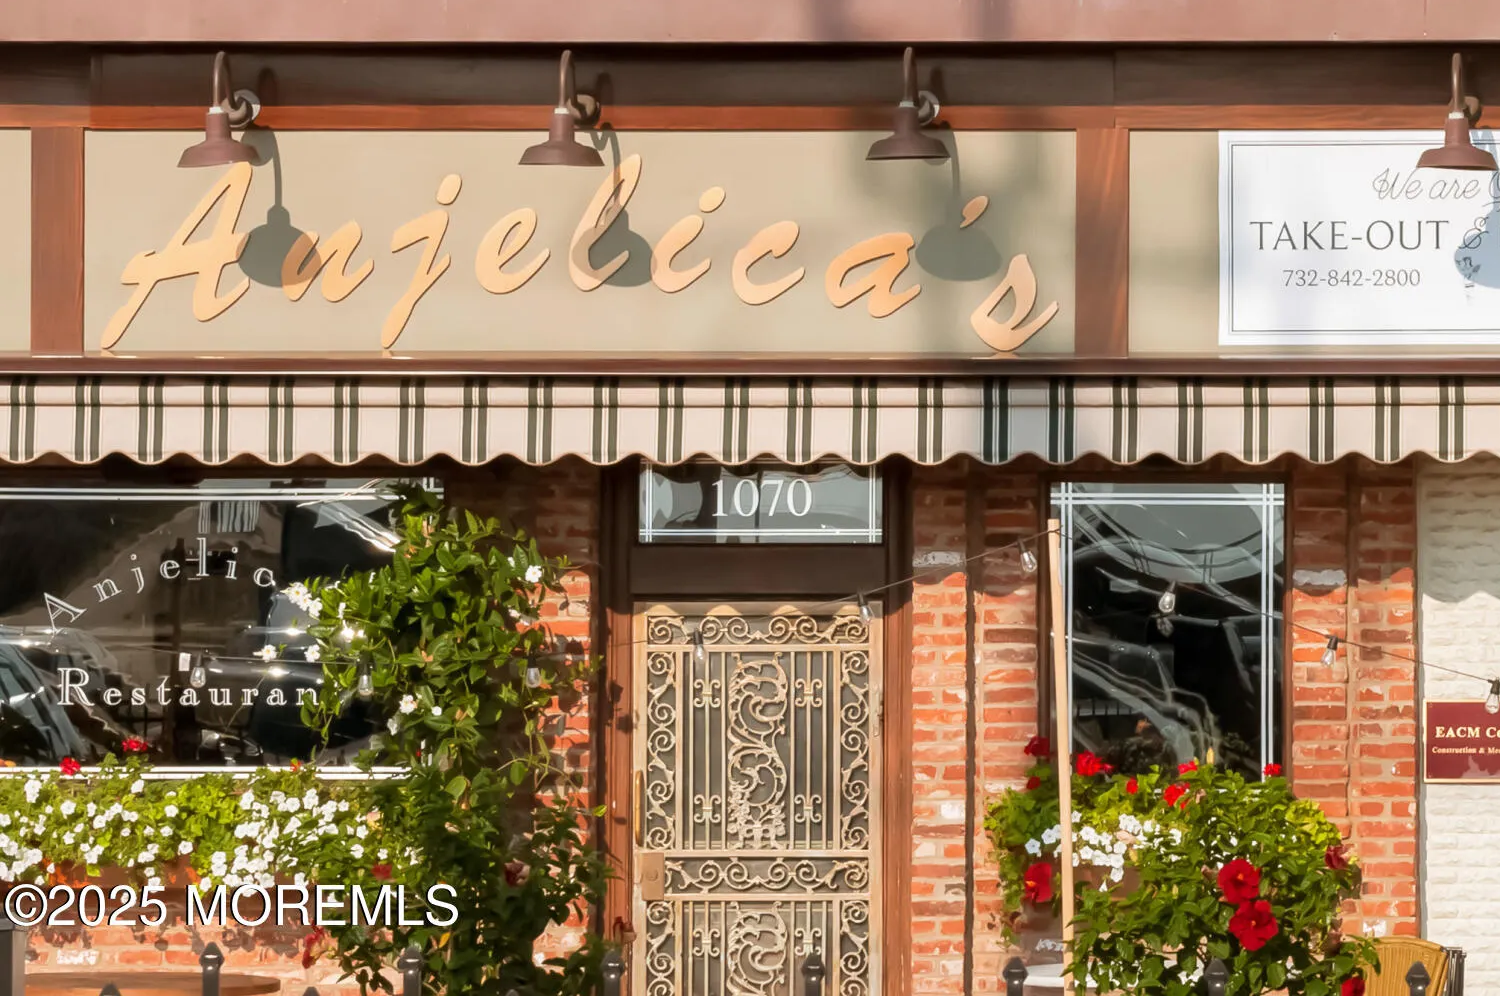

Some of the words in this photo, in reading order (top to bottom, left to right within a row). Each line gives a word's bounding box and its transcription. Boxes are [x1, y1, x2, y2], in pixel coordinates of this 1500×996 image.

[1372, 167, 1424, 201] We
[1428, 178, 1482, 201] are
[1249, 219, 1450, 251] TAKE-OUT
[1458, 215, 1490, 250] &
[100, 154, 1060, 353] Anjelica's
[1282, 268, 1421, 288] 732-842-2800
[710, 477, 814, 518] 1070
[42, 536, 279, 635] Anjelic
[56, 666, 321, 706] Restauran
[1435, 725, 1481, 739] EACM
[1431, 746, 1477, 755] Construction
